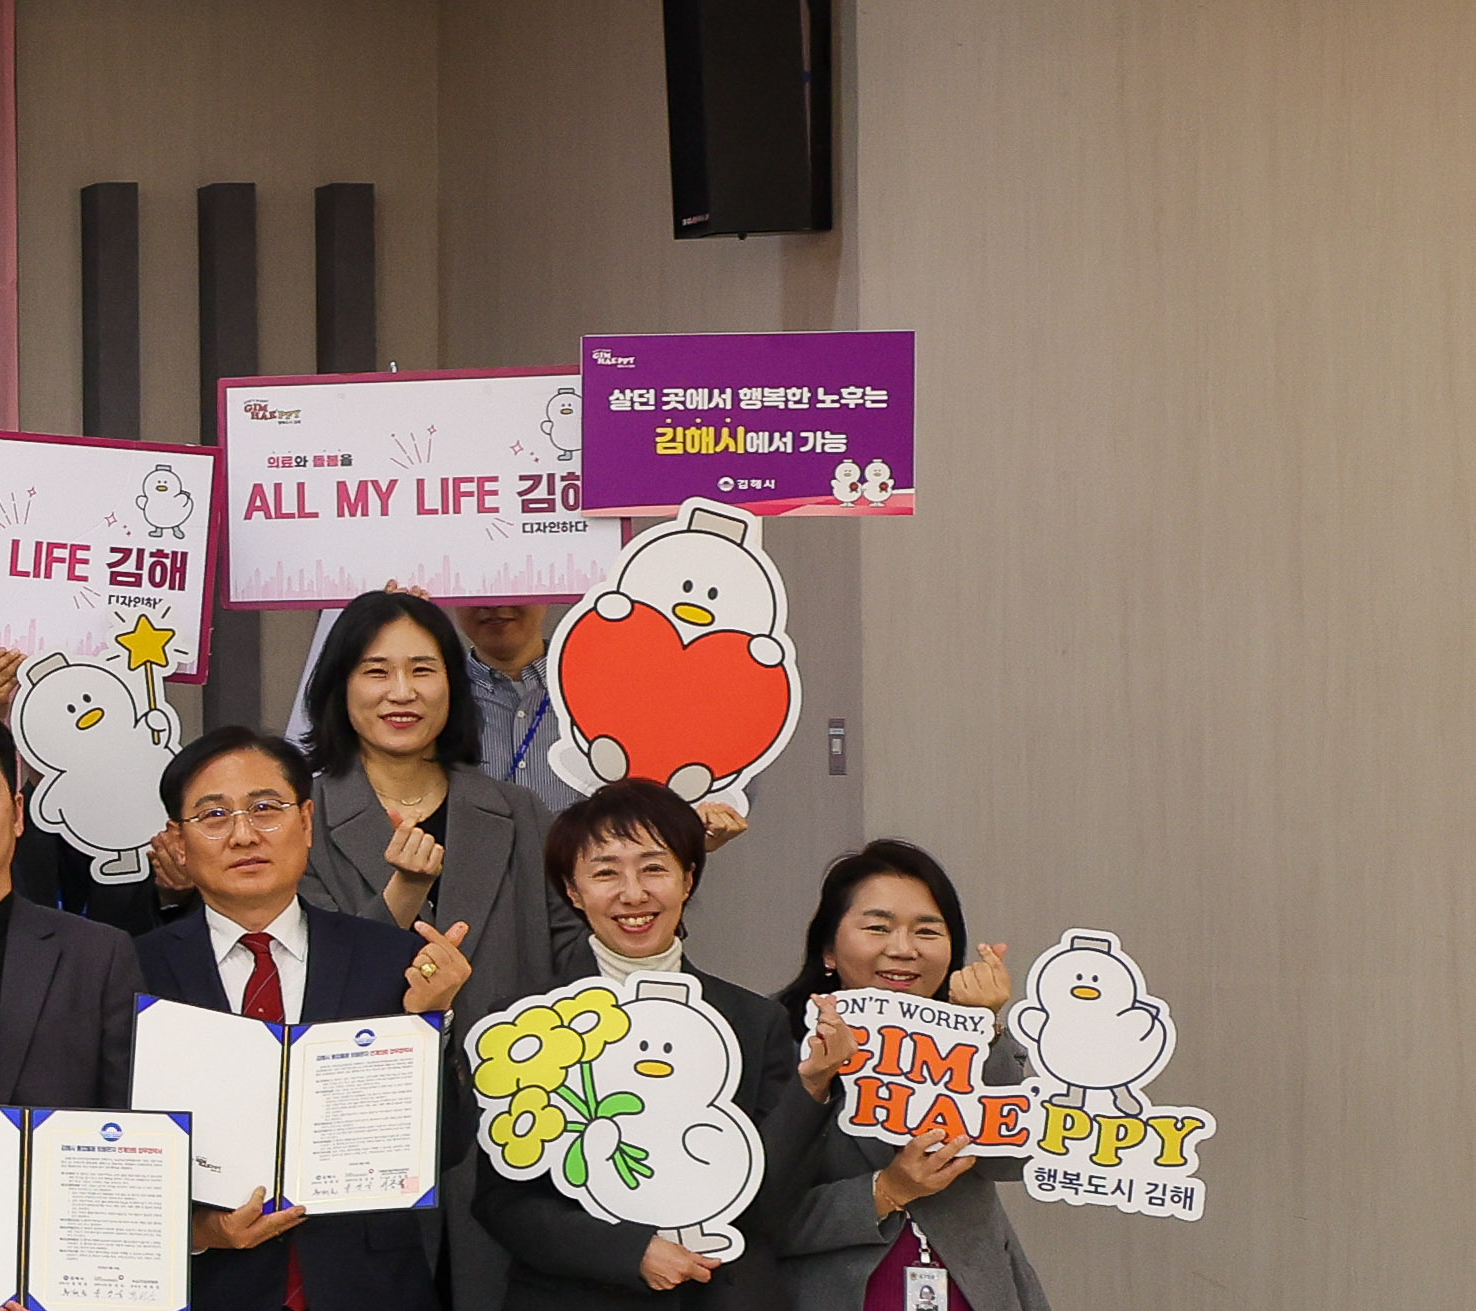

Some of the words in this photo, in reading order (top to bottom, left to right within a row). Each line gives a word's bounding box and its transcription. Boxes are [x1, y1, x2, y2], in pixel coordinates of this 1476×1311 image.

[608, 388, 657, 411] 살던
[661, 388, 733, 411] 곳에서
[738, 386, 811, 410] 행복한
[815, 386, 888, 409] 노후는
[655, 426, 793, 454] 김해시에서
[799, 430, 848, 454] 가능
[267, 455, 308, 468] 의료와
[737, 479, 776, 489] 김해시
[243, 480, 319, 521] ALL
[336, 479, 399, 518] MY
[415, 475, 500, 516] LIFE
[522, 521, 589, 534] 디자인하다
[8, 538, 92, 582] LIFE
[106, 546, 189, 591] 김해
[825, 995, 890, 1018] ON'T
[1033, 1166, 1134, 1204] 행복도시
[1144, 1180, 1195, 1212] 김해
